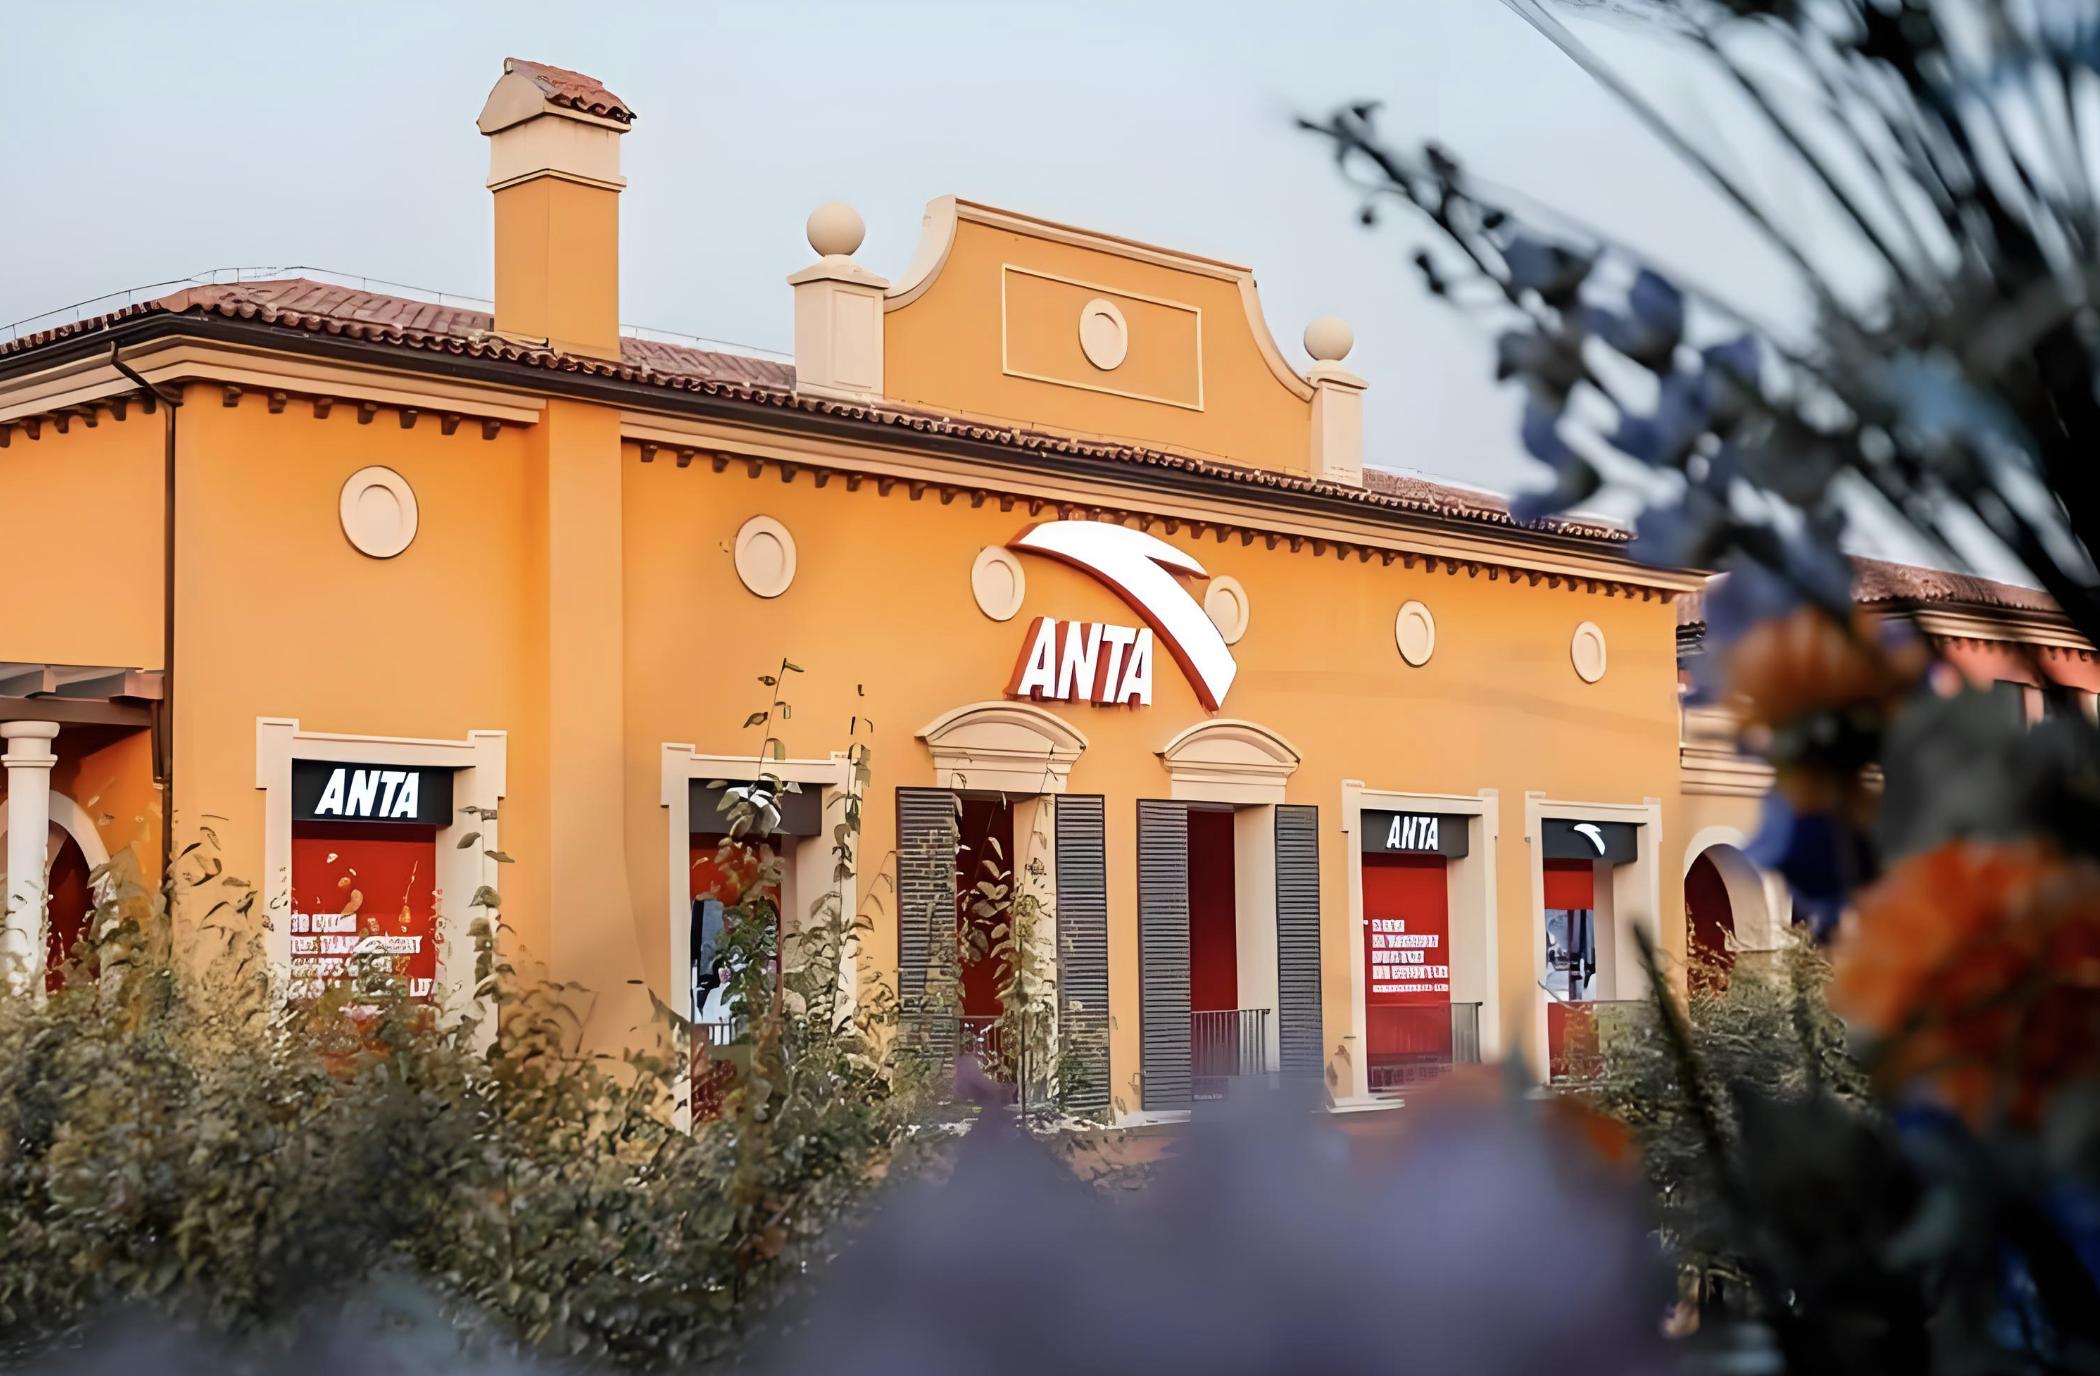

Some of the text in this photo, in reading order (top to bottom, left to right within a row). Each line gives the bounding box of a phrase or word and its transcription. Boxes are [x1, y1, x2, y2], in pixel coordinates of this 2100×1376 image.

[1017, 616, 1153, 706] ANTA
[314, 768, 419, 818] ANTA
[1386, 815, 1439, 850] ANTA
